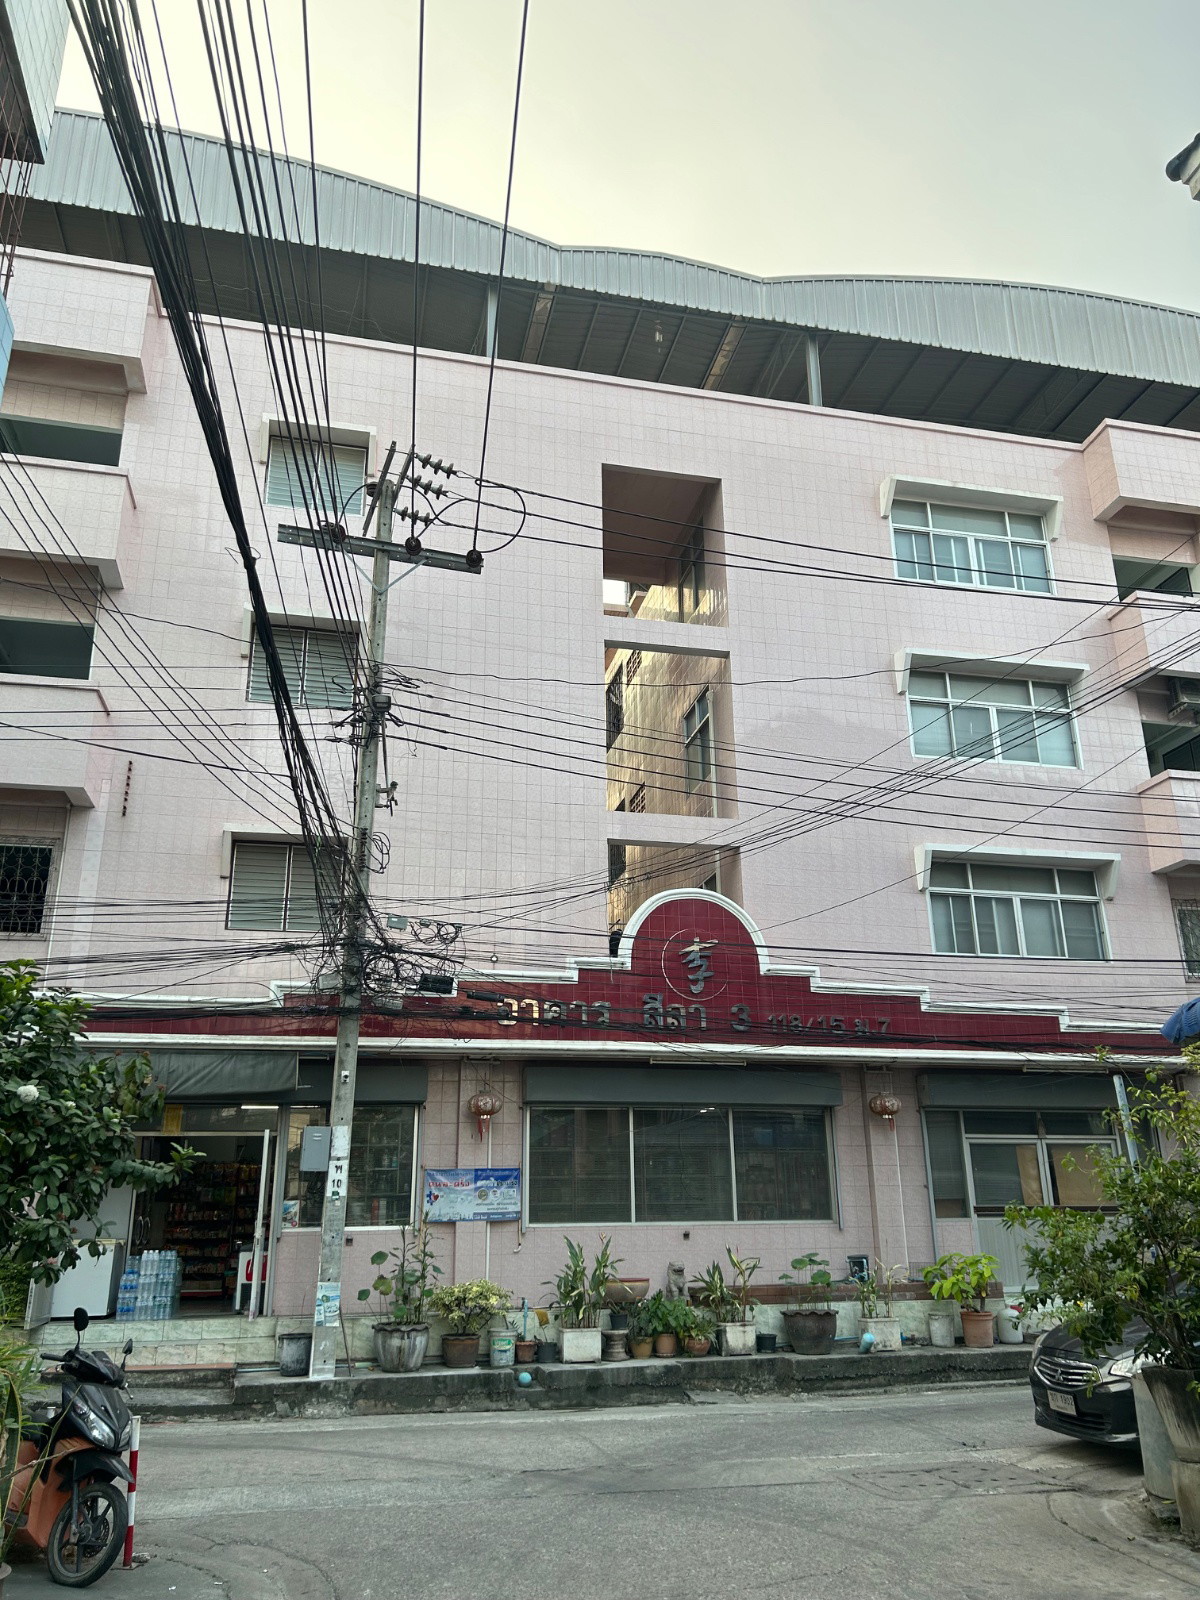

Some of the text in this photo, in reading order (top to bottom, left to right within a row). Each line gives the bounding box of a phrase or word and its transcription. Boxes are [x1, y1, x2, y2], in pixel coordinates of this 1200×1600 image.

[679, 936, 719, 993] 李
[497, 997, 611, 1027] อาคาร
[731, 1003, 752, 1031] 3
[767, 1014, 845, 1032] 118/15
[332, 1179, 342, 1188] 10
